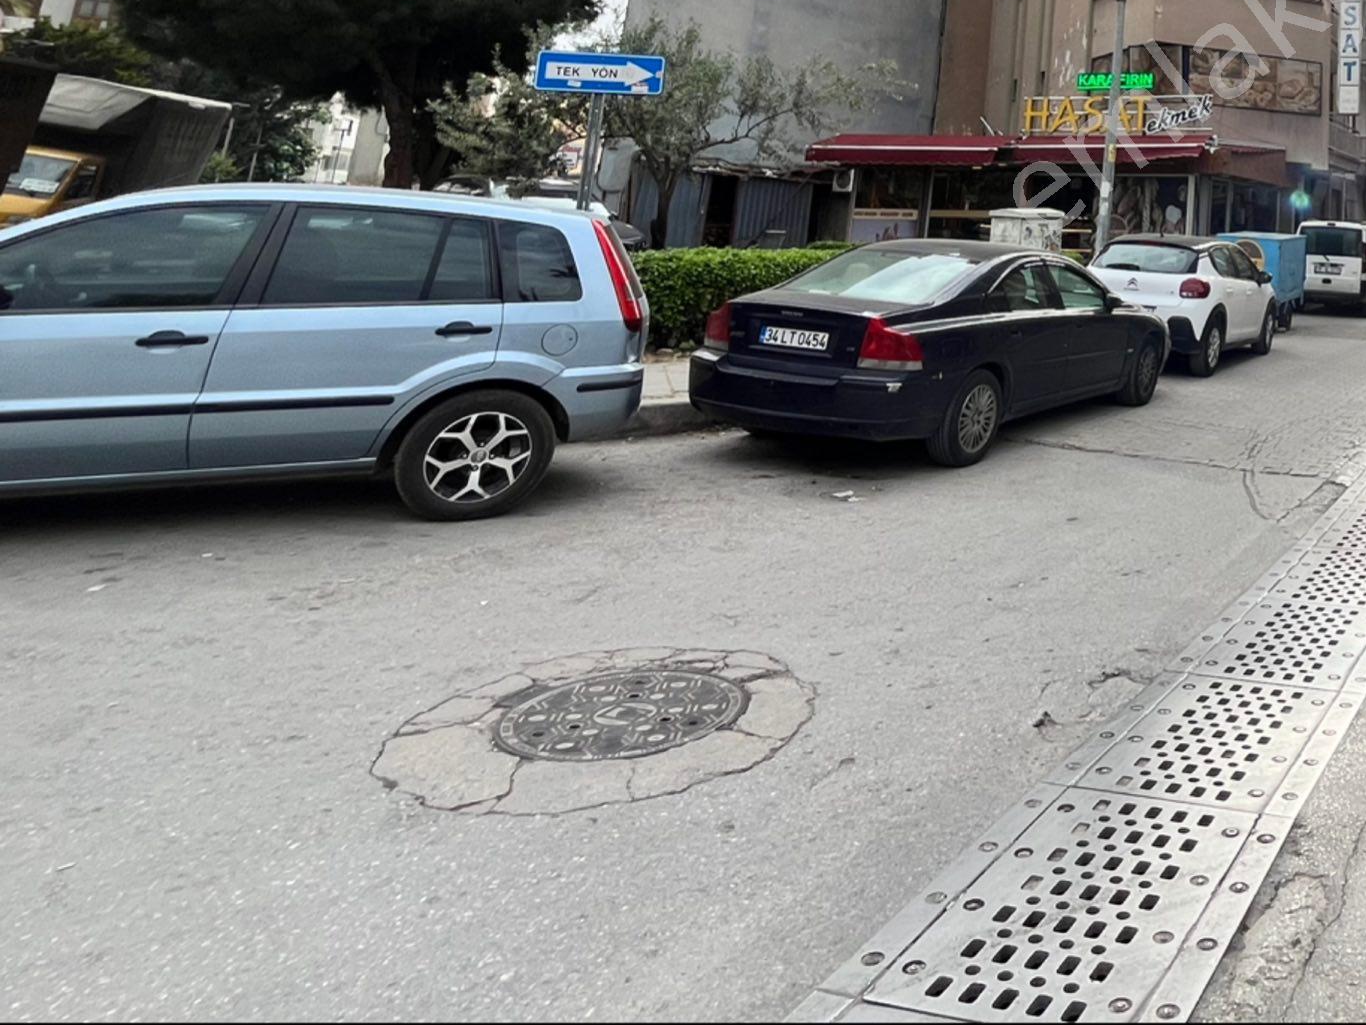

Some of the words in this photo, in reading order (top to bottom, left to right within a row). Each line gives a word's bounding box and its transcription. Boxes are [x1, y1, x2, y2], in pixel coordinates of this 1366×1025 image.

[555, 66, 580, 77] TEK
[591, 67, 618, 78] YÖN
[1078, 74, 1114, 87] KARA
[1119, 74, 1153, 87] FIRIN
[1024, 96, 1147, 134] HASAT
[1145, 95, 1213, 134] ekmek
[765, 327, 778, 343] 34
[798, 332, 826, 349] 0454
